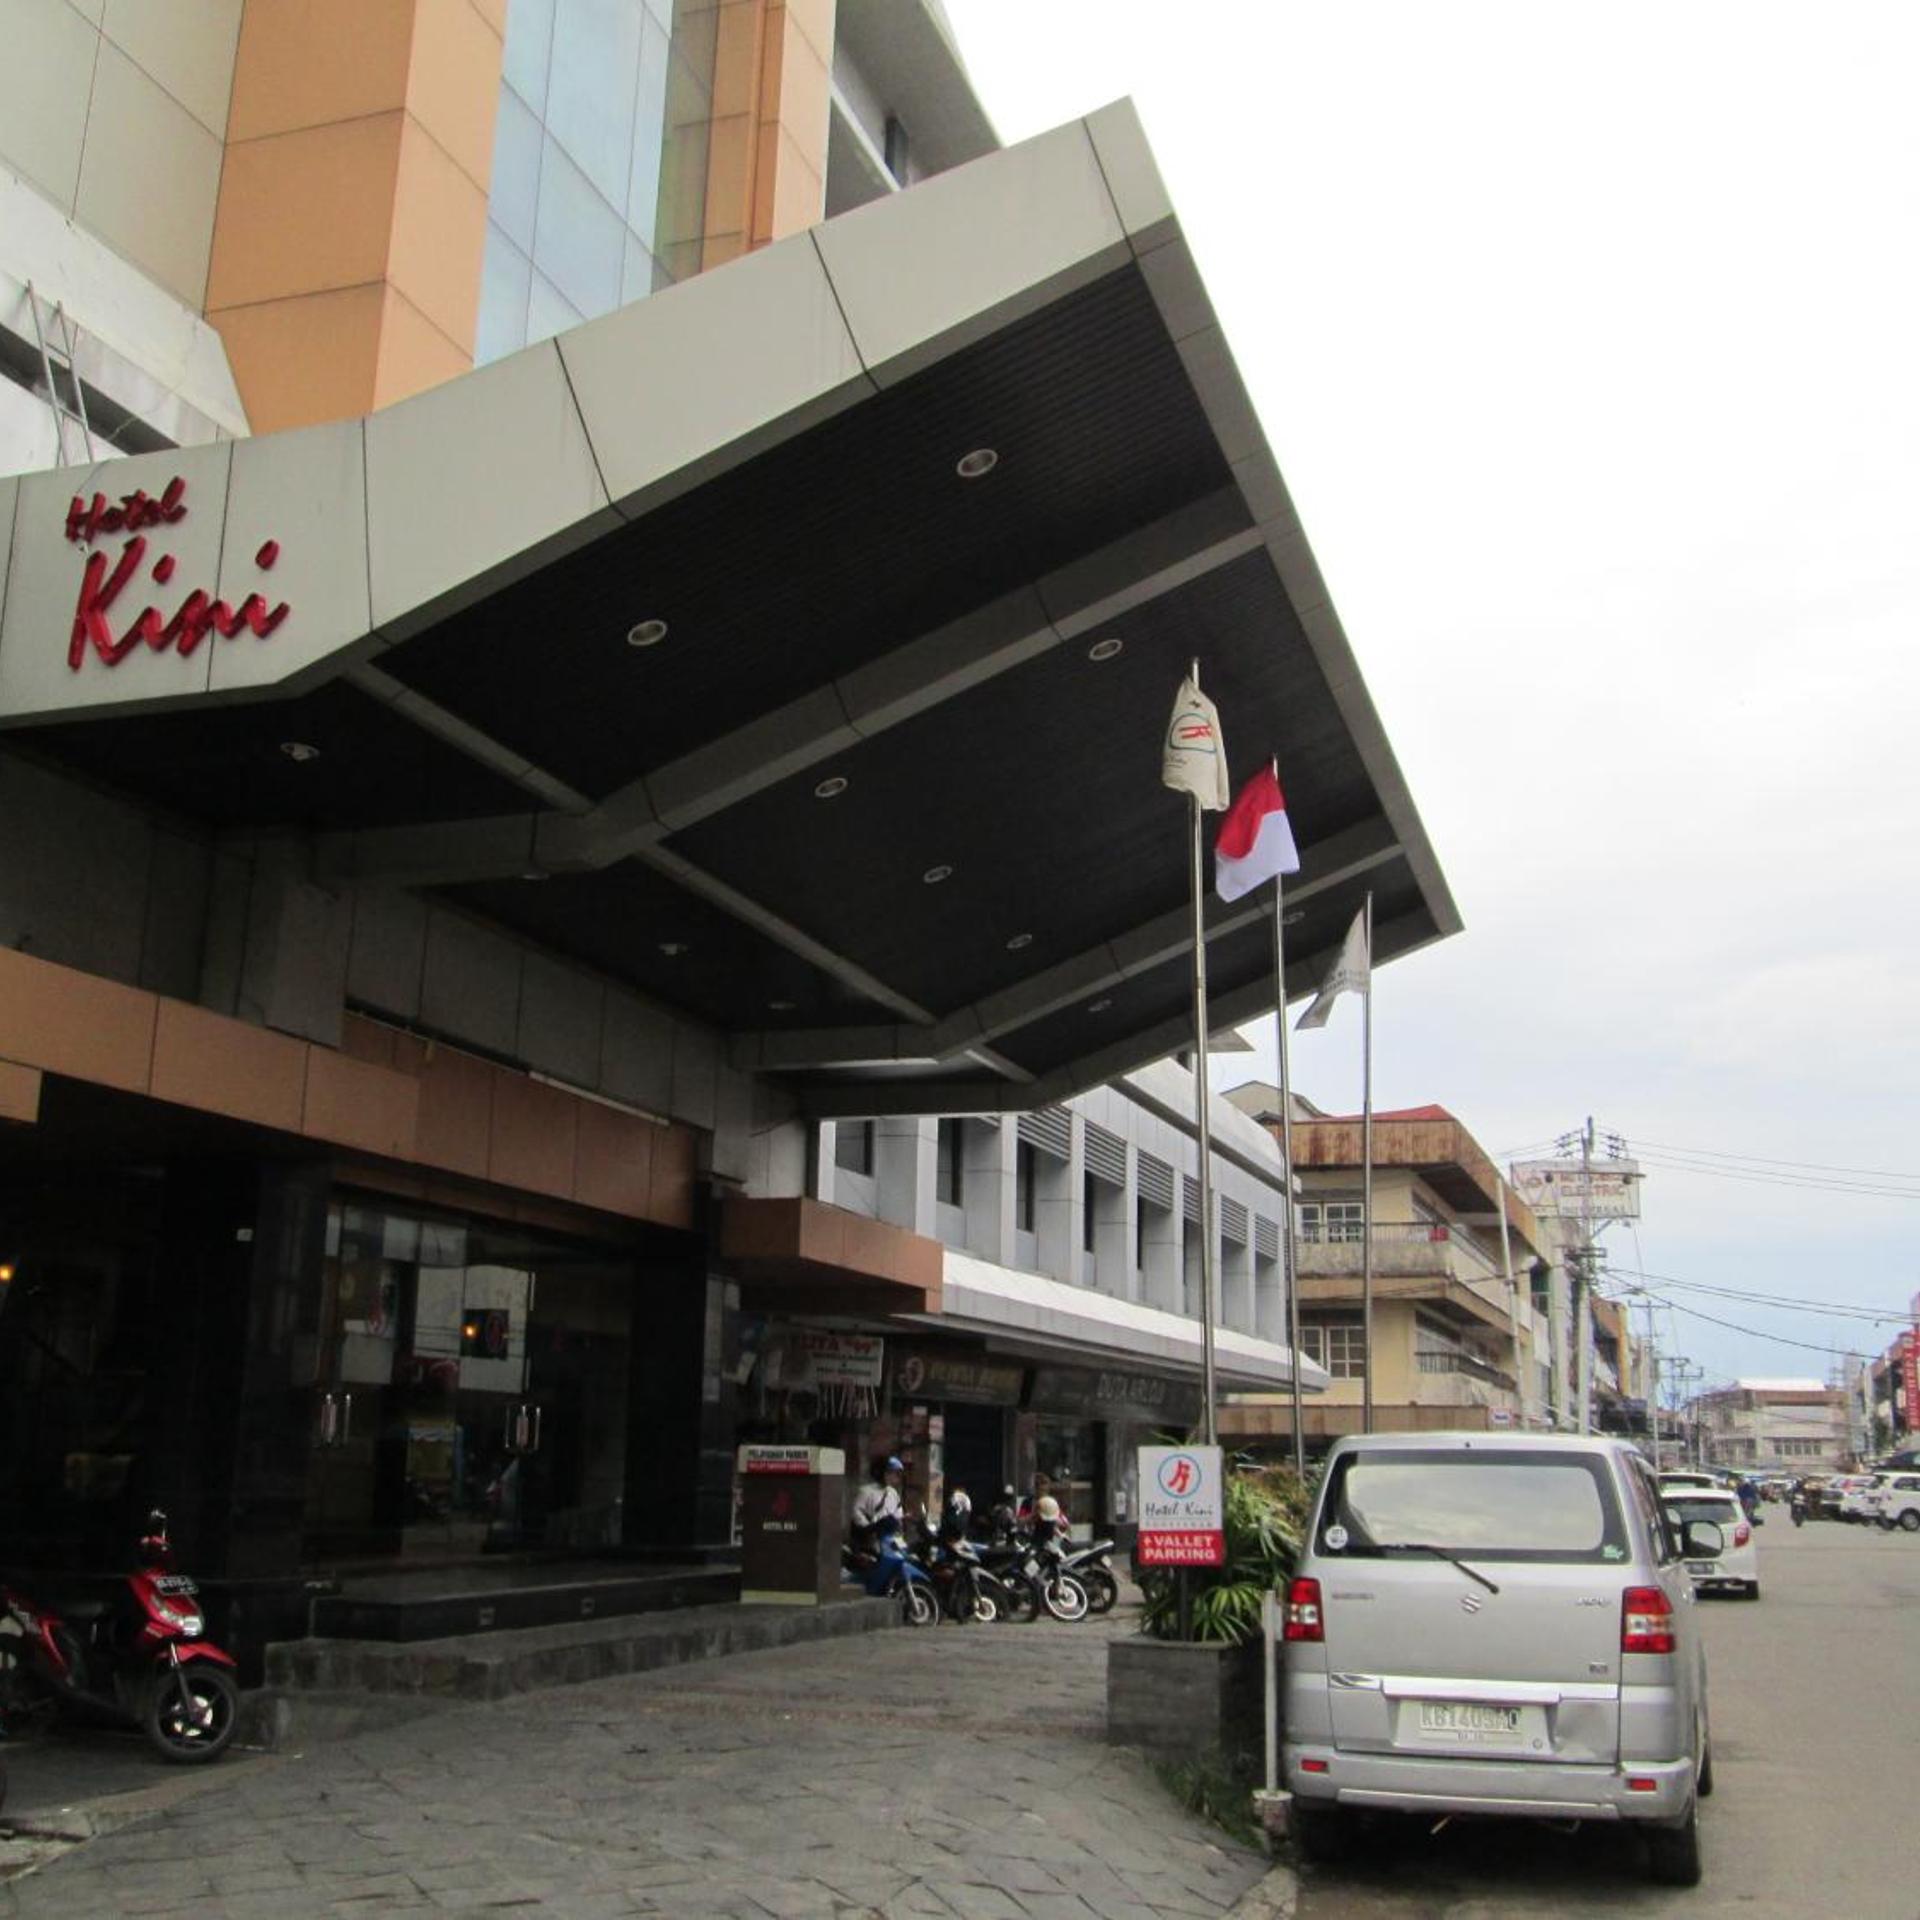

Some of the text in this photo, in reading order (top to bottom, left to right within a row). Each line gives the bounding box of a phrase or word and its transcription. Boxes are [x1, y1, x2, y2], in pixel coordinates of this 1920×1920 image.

[65, 476, 188, 543] Hotel
[68, 535, 291, 672] Kini
[1145, 1502, 1214, 1517] Hotel Kini
[1153, 1535, 1214, 1547] VALLET
[1144, 1548, 1217, 1560] PARKING
